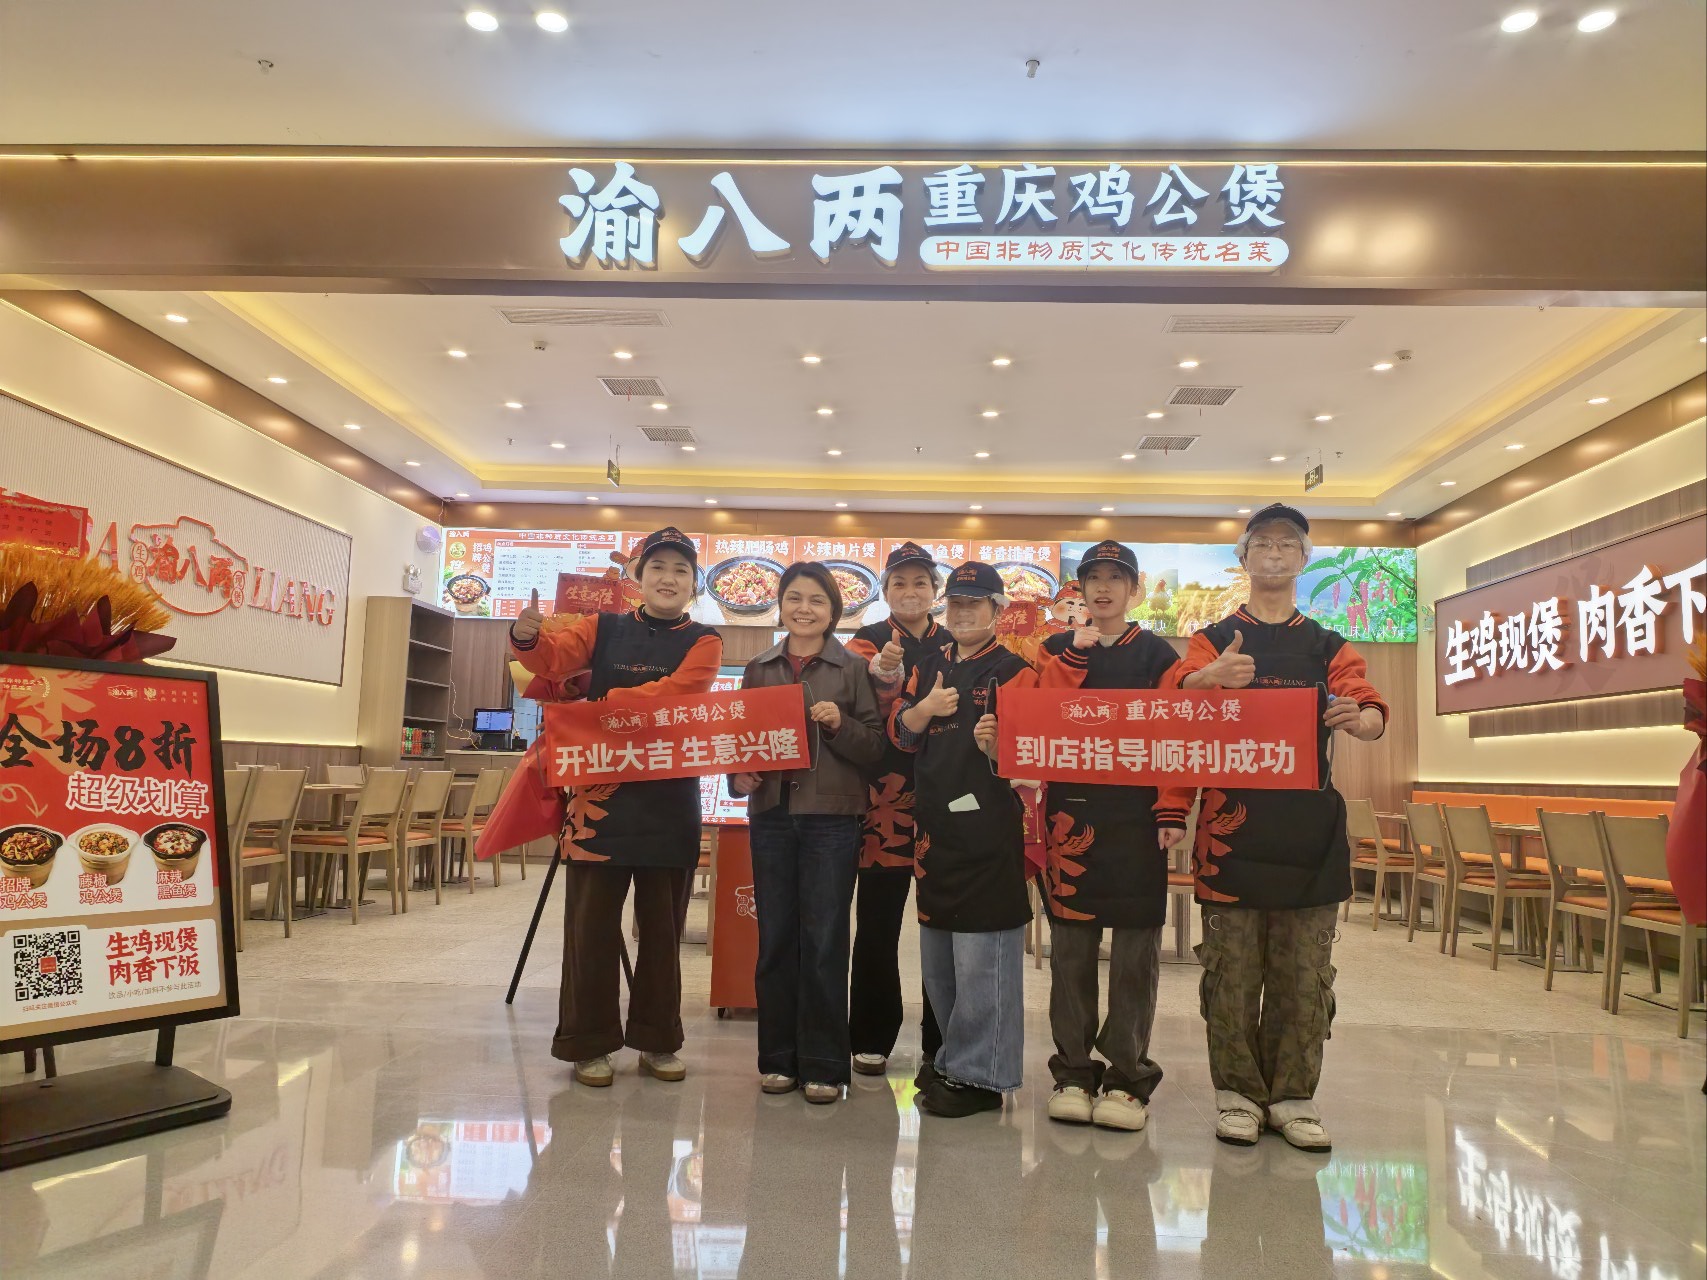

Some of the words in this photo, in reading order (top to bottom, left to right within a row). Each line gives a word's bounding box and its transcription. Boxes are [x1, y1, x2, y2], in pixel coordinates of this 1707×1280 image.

[558, 161, 904, 267] 渝八两
[923, 163, 1287, 231] 重庆鸡公煲
[935, 240, 1274, 264] 中国非物质文化传统名菜
[803, 541, 876, 558] 火辣肉片煲
[979, 545, 1052, 562] 酱香排骨煲
[148, 533, 234, 599] 渝八两
[249, 565, 335, 627] LIANG
[1444, 596, 1565, 686] 生鸡现煲
[1577, 558, 1707, 663] 肉香下
[1284, 679, 1306, 687] LIANG
[607, 713, 642, 730] 渝八两
[653, 700, 746, 727] 重庆鸡公煲
[1069, 703, 1111, 719] 渝八两
[1126, 698, 1241, 722] 重庆鸡公煲
[0, 713, 198, 779] 全场8折
[556, 738, 674, 777] 开业大吉
[681, 727, 801, 769] 生意兴隆
[1015, 735, 1296, 775] 到店指导顺利成功
[66, 771, 209, 819] 超级划算
[0, 876, 32, 893] 招牌
[78, 873, 109, 889] 藤椒
[156, 869, 183, 885] 麻辣
[0, 891, 48, 910] 鸡公煲
[79, 887, 123, 905] 鸡公煲
[157, 883, 197, 900] 黑鱼煲
[105, 926, 199, 961] 生鸡现煲
[108, 952, 201, 986] 肉香下饭
